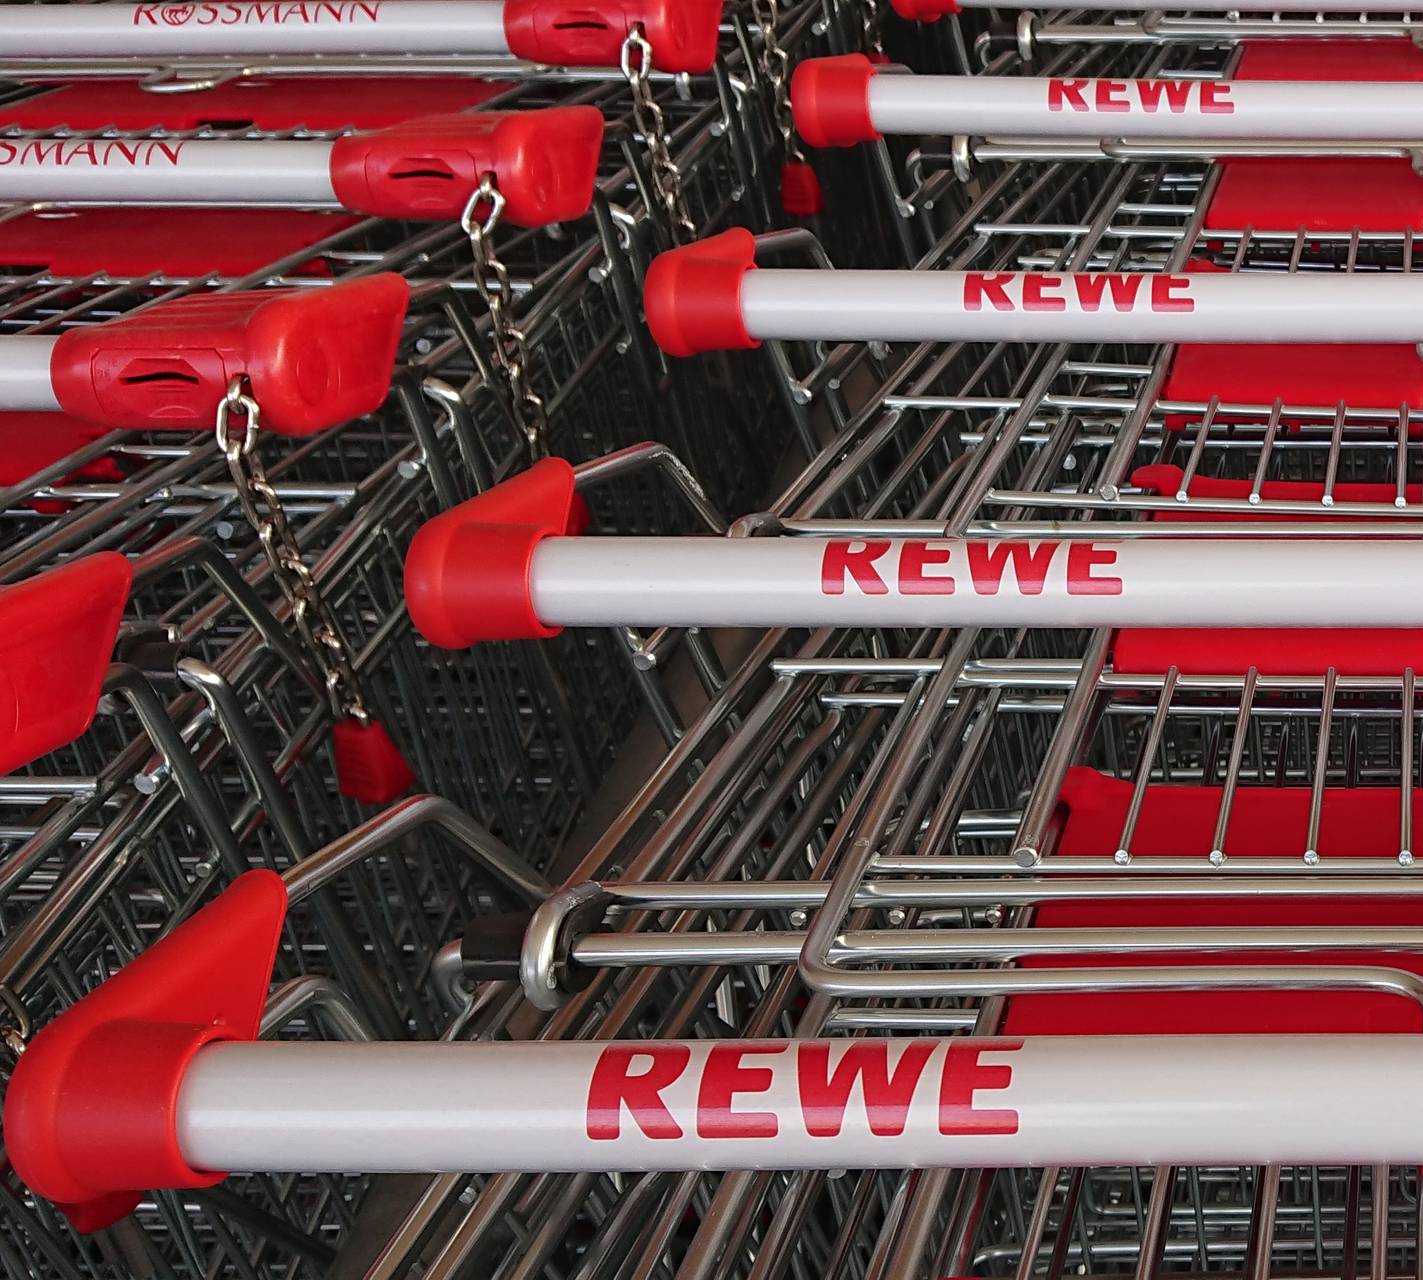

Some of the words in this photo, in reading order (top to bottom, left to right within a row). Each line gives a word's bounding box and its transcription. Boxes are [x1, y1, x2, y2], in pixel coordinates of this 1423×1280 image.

[1048, 79, 1236, 113] REWE
[963, 273, 1195, 312] REWE
[821, 541, 1123, 596] REWE
[586, 1040, 1025, 1139] REWE
